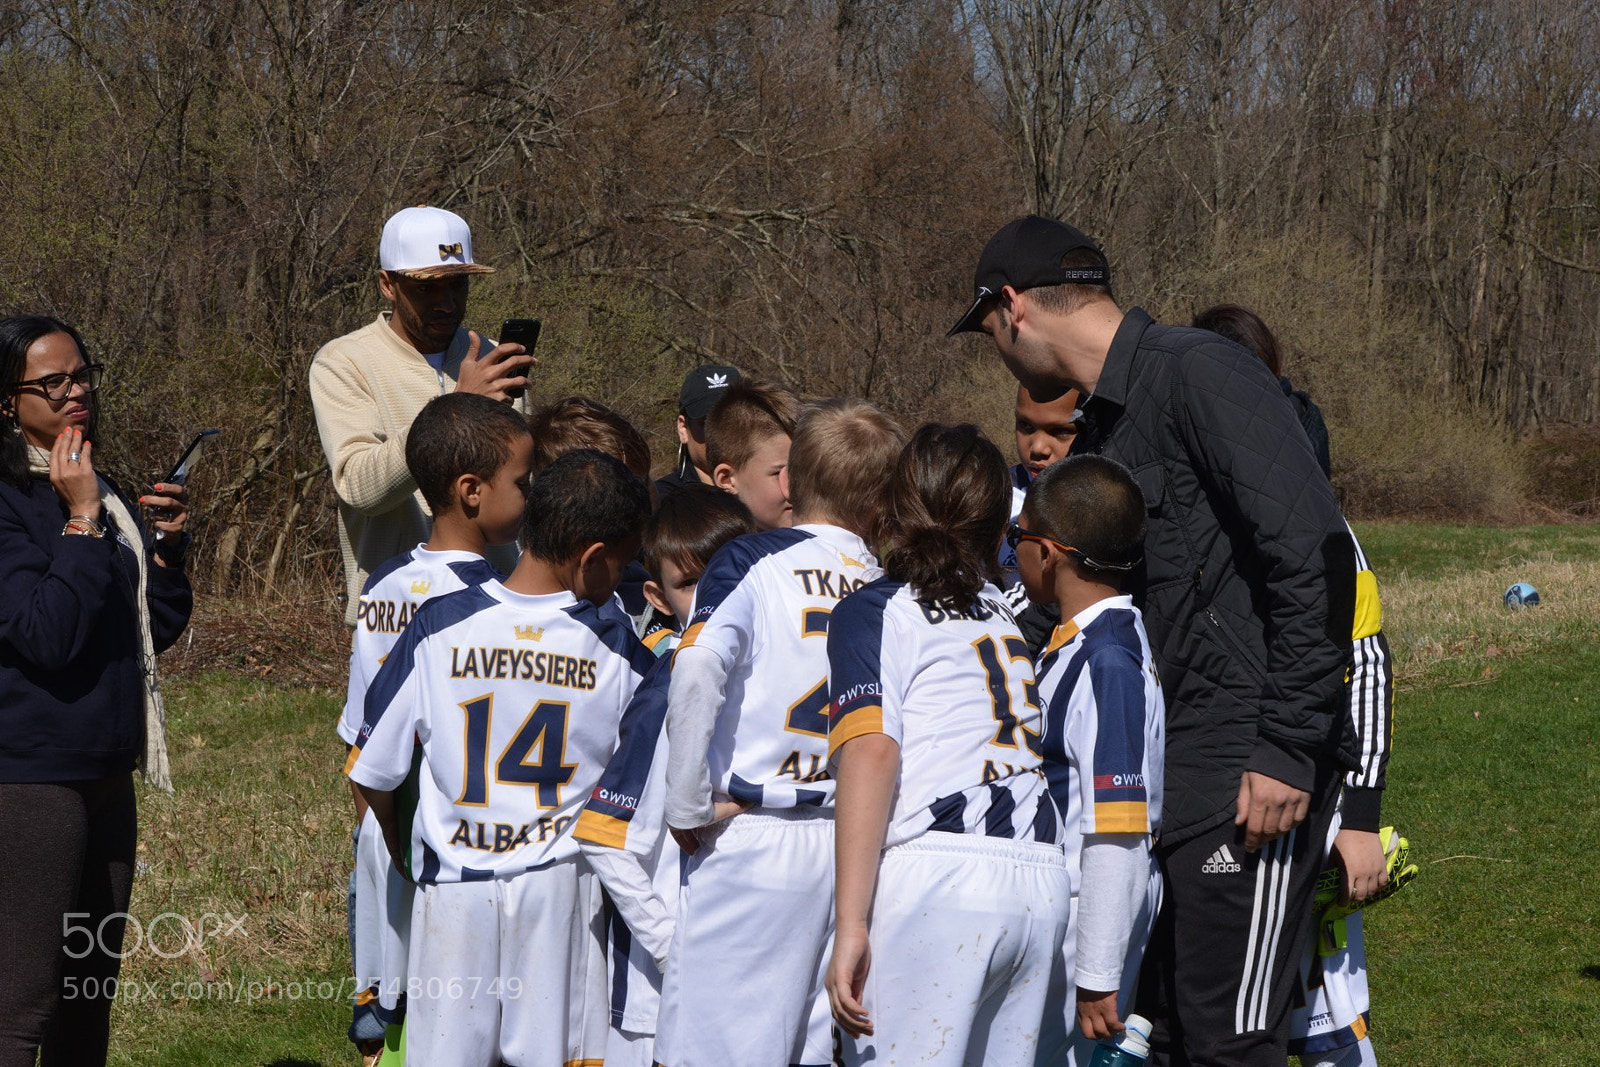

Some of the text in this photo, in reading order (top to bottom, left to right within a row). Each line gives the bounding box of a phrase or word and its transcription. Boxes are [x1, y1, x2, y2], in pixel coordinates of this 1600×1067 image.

[1065, 270, 1104, 279] REFEREE
[450, 648, 597, 691] LAVEYSSIERES
[847, 682, 883, 701] WYSL
[453, 692, 579, 810] 14
[610, 791, 638, 810] WYSL
[448, 818, 535, 855] ALBA
[1201, 861, 1241, 874] adidas
